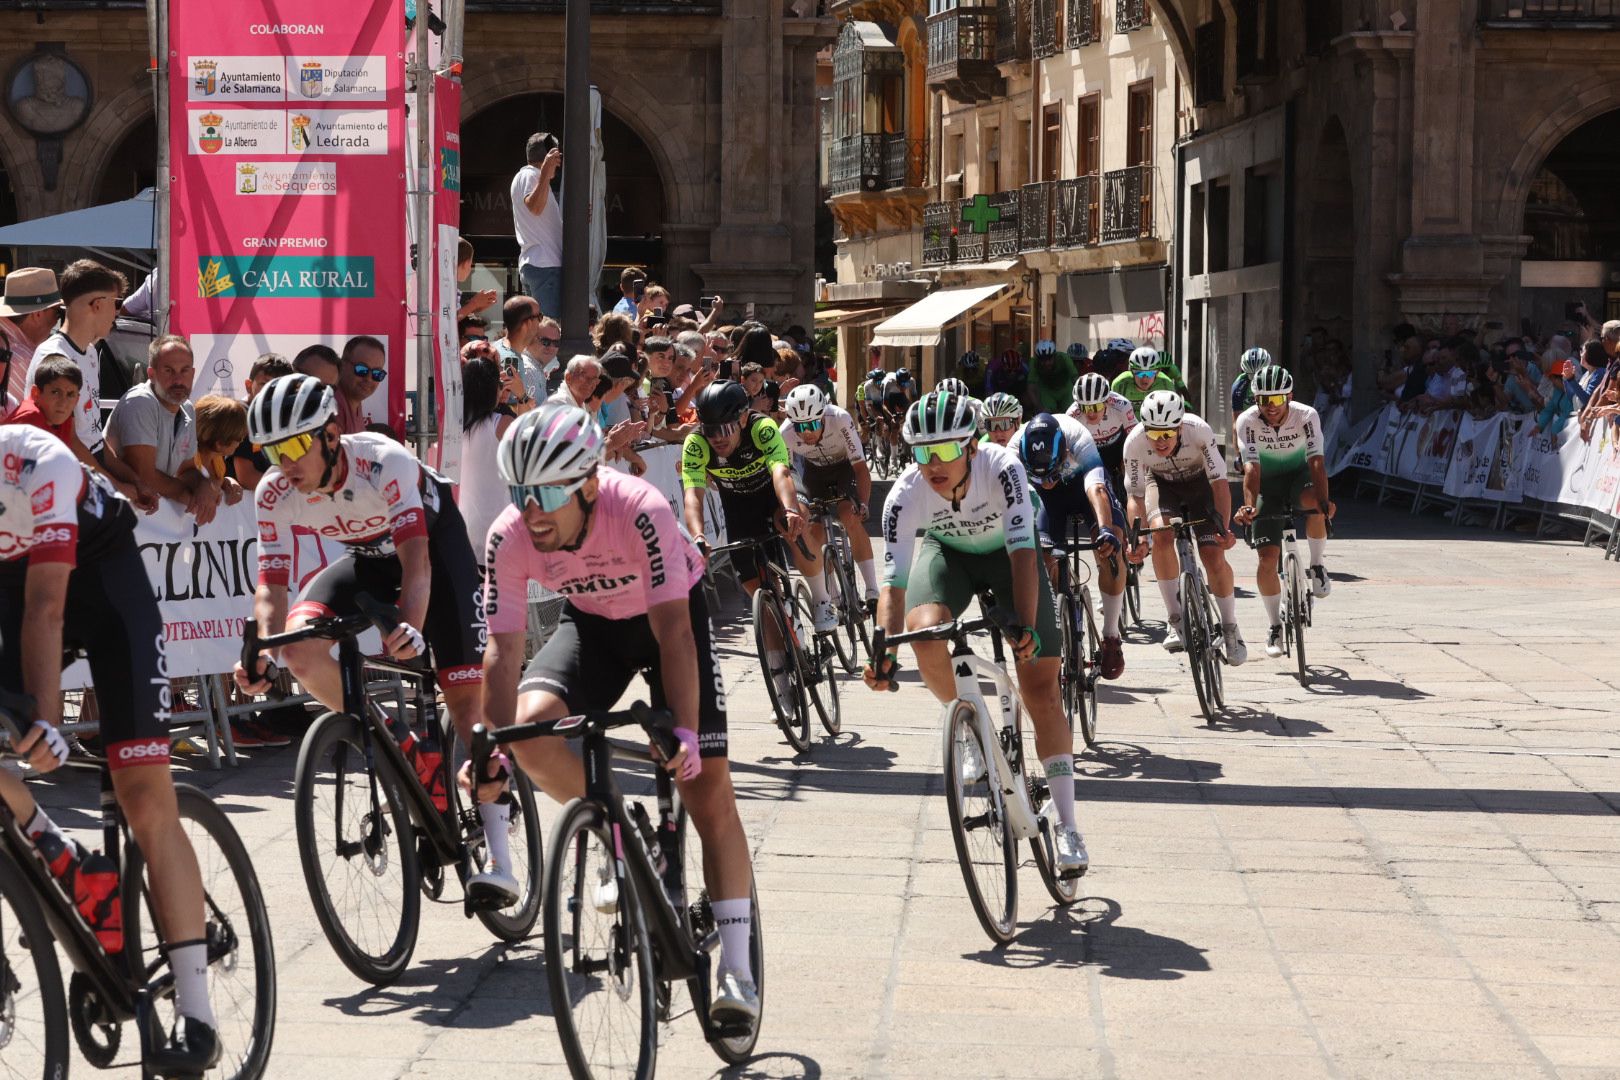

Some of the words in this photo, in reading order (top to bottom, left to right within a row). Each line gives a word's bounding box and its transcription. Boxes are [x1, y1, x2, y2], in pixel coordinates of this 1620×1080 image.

[249, 23, 324, 35] COLABORAN
[220, 72, 281, 84] Ayuntamiento
[324, 69, 368, 78] Diputación
[220, 83, 231, 93] de
[234, 84, 281, 93] Salamanca
[334, 84, 377, 93] Salamanca
[225, 120, 267, 131] Ayuntamiento
[269, 120, 278, 130] de
[315, 122, 374, 131] Ayuntamiento
[377, 122, 388, 130] de
[224, 138, 232, 146] La
[234, 137, 257, 147] Alberca
[316, 135, 370, 147] Ledrada
[262, 171, 336, 181] Ayuntamiento
[275, 180, 336, 194] Sequeros
[242, 237, 278, 248] GRAN
[279, 237, 328, 248] PREMIO
[242, 270, 293, 292] CAJA
[298, 270, 369, 288] RURAL
[1264, 442, 1295, 450] ALEA
[998, 469, 1016, 509] RGA
[1006, 464, 1024, 506] SEGUROS
[257, 475, 290, 511] telc
[888, 505, 903, 543] RGA
[942, 524, 995, 537] ALEA
[634, 512, 667, 590] GOMUR
[226, 618, 234, 638] Y
